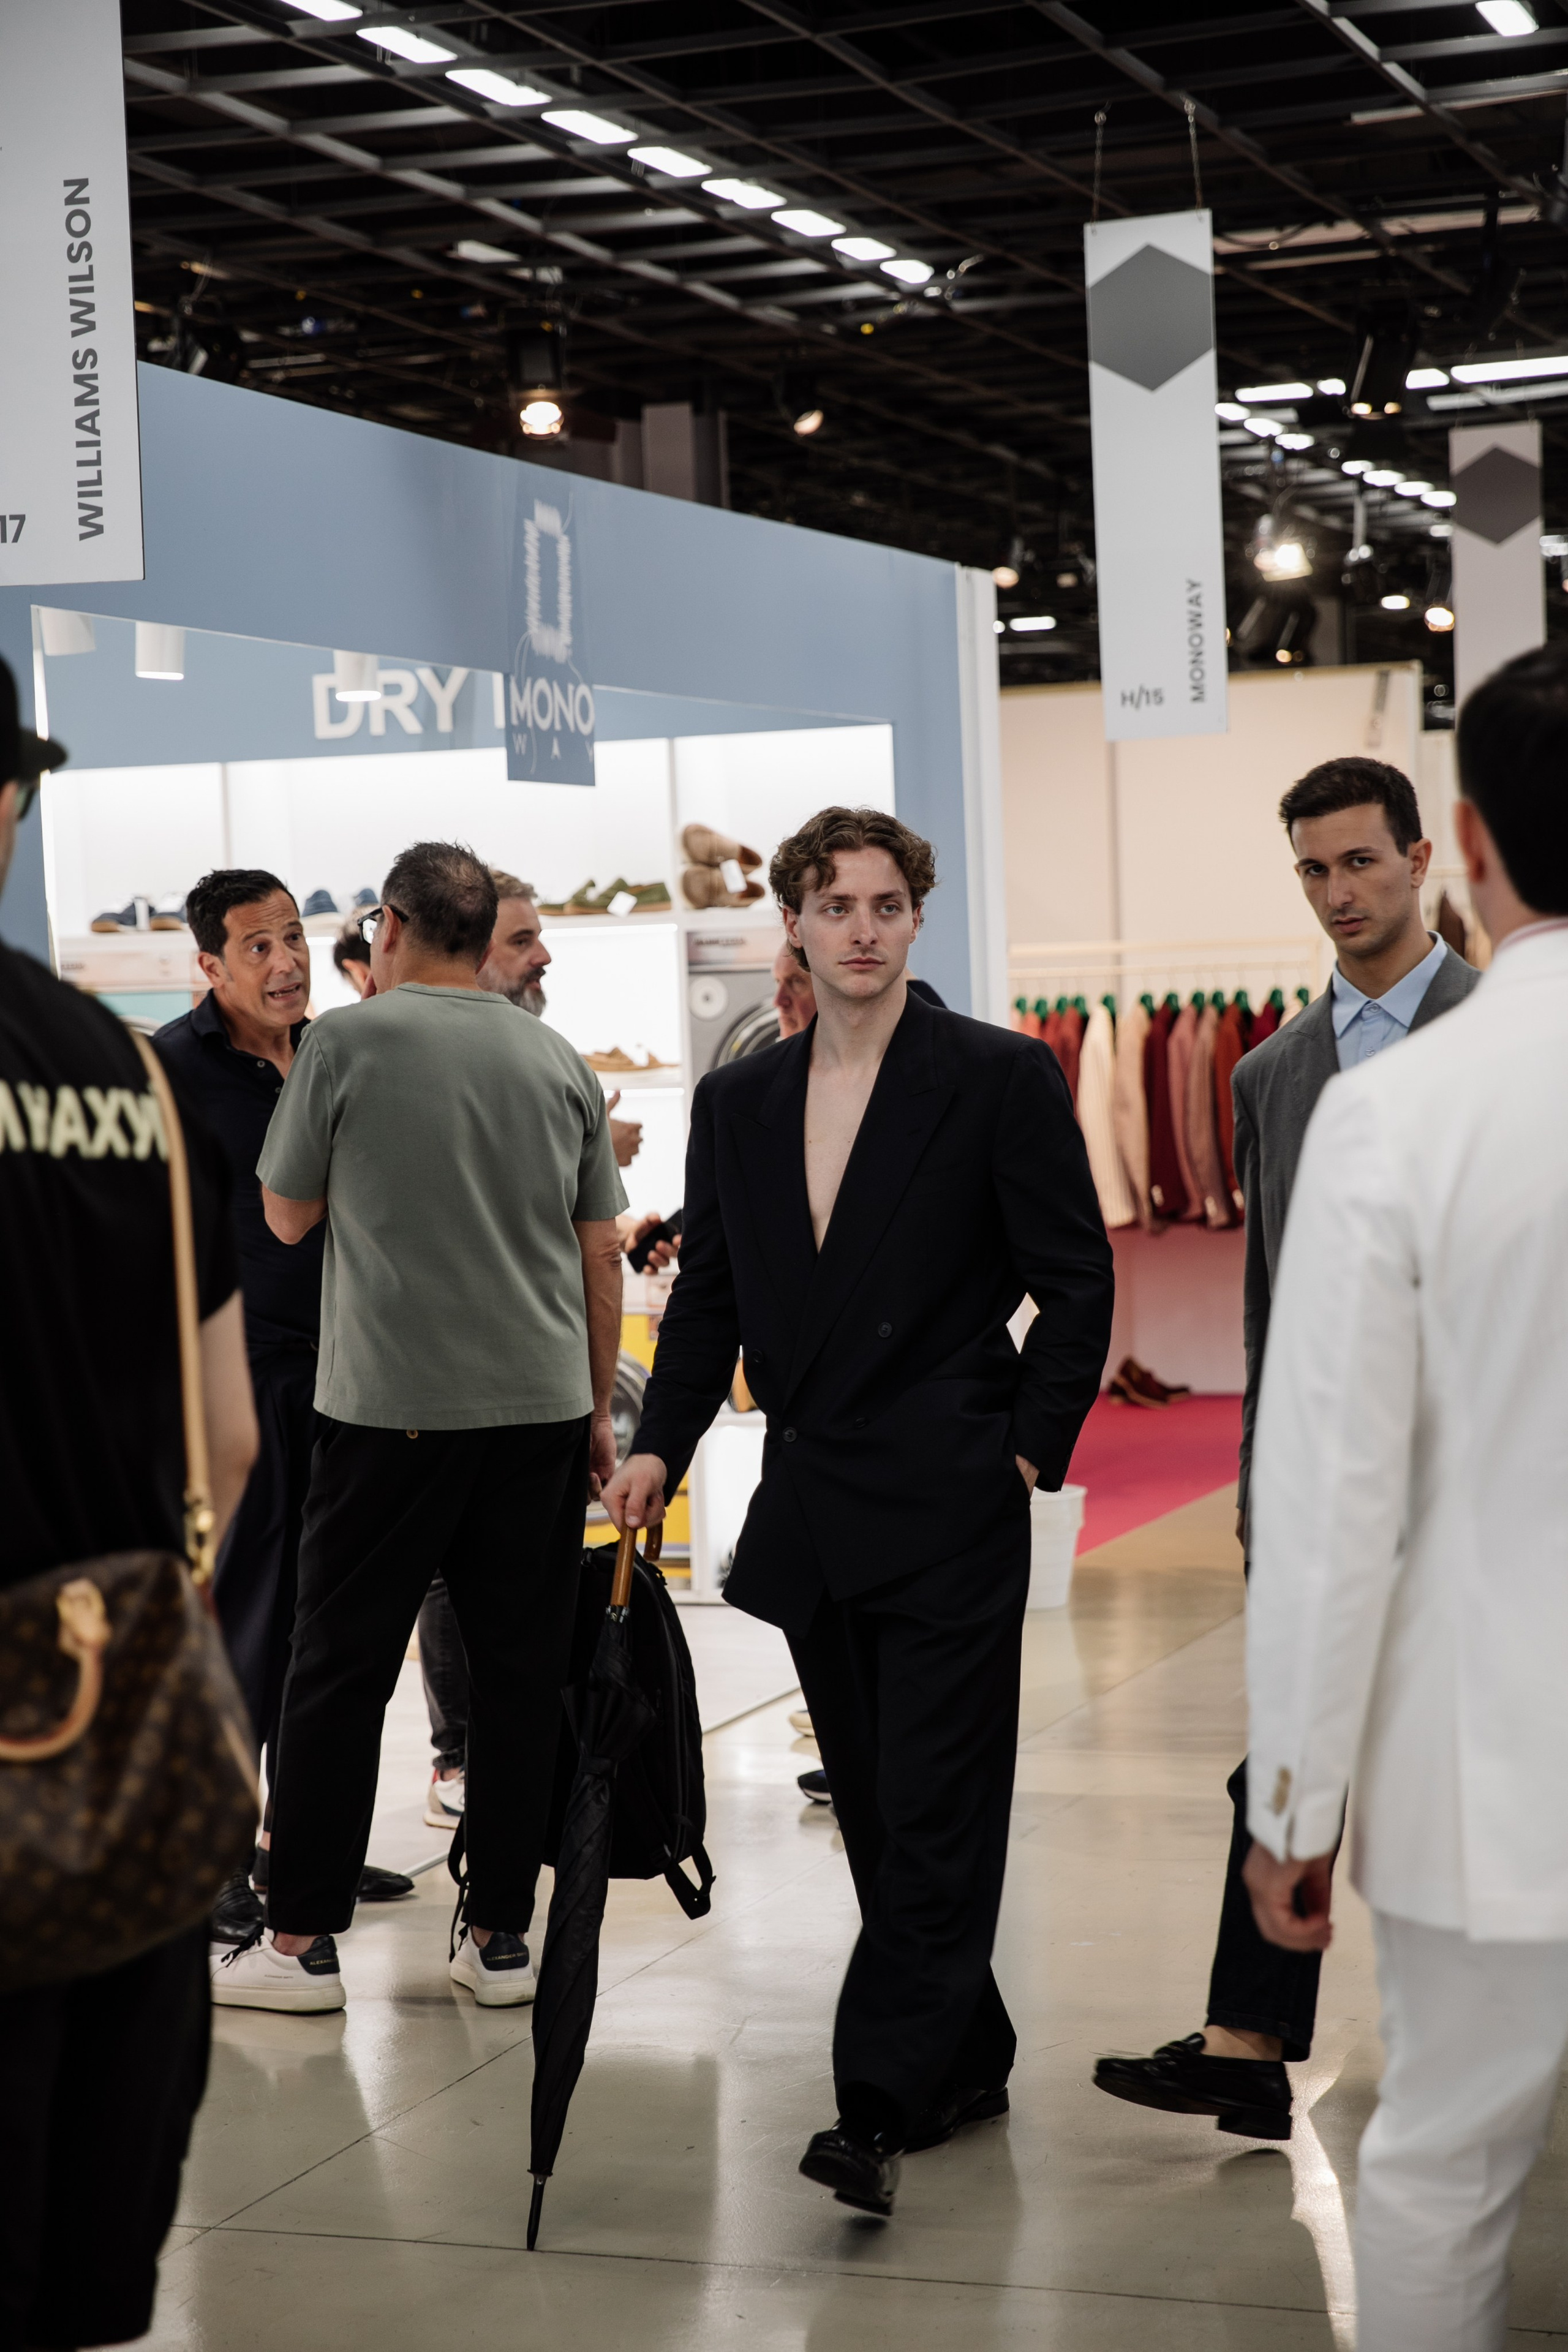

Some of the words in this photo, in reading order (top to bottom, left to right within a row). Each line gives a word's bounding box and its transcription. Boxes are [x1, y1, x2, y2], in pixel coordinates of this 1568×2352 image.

[63, 178, 97, 338] WILSON
[72, 347, 104, 541] WILLIAMS
[1186, 578, 1205, 703] MONOWAY
[312, 667, 469, 739] DRY
[510, 675, 595, 736] MONO
[1120, 683, 1164, 710] H/15
